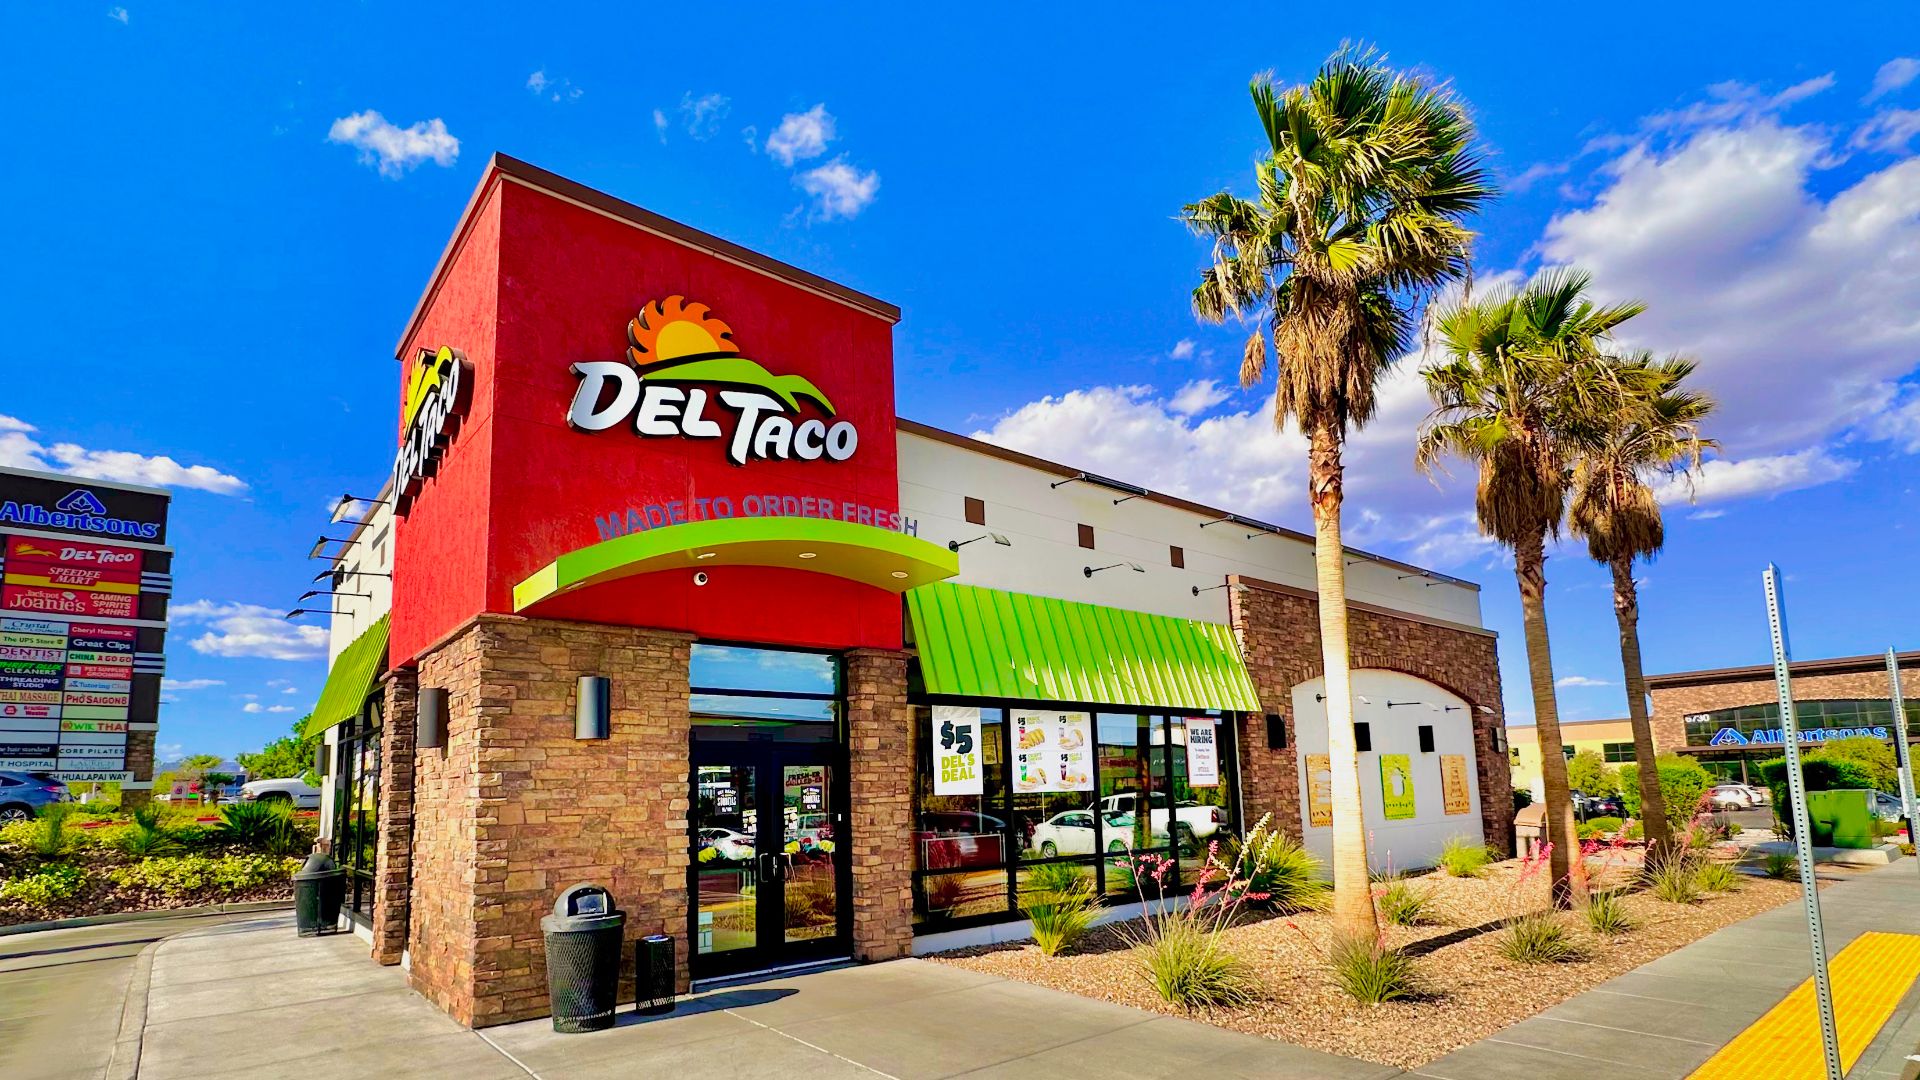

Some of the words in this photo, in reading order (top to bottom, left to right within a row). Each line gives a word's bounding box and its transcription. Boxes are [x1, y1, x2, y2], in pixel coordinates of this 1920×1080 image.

[419, 357, 460, 476] TACO
[567, 361, 722, 438] DEL
[719, 390, 858, 465] TACO
[0, 501, 160, 538] Albertsons
[594, 500, 688, 541] MADE
[693, 496, 733, 520] TO
[743, 495, 834, 520] ORDER
[842, 501, 918, 538] FRESH
[59, 547, 96, 561] DEL
[96, 550, 134, 564] TACO
[48, 567, 102, 579] SPEEDEE
[55, 575, 93, 584] MART
[25, 590, 59, 600] Jackpot
[90, 592, 131, 602] GAMING
[10, 594, 85, 612] Joanie's
[92, 600, 131, 610] SPIRITS
[97, 608, 130, 616] 24HRS
[73, 639, 104, 648] Great
[106, 641, 131, 650] Clips
[0, 648, 64, 657] DENTIST
[4, 667, 57, 675] CLEANERS
[0, 676, 59, 684] THREADING
[20, 692, 59, 702] MASSAGE
[97, 723, 129, 731] THAI
[940, 720, 973, 754] $5
[1190, 736, 1213, 744] HIRING
[941, 753, 975, 769] DEL'S
[62, 773, 106, 781] HUALAPAI
[942, 767, 975, 783] DEAL
